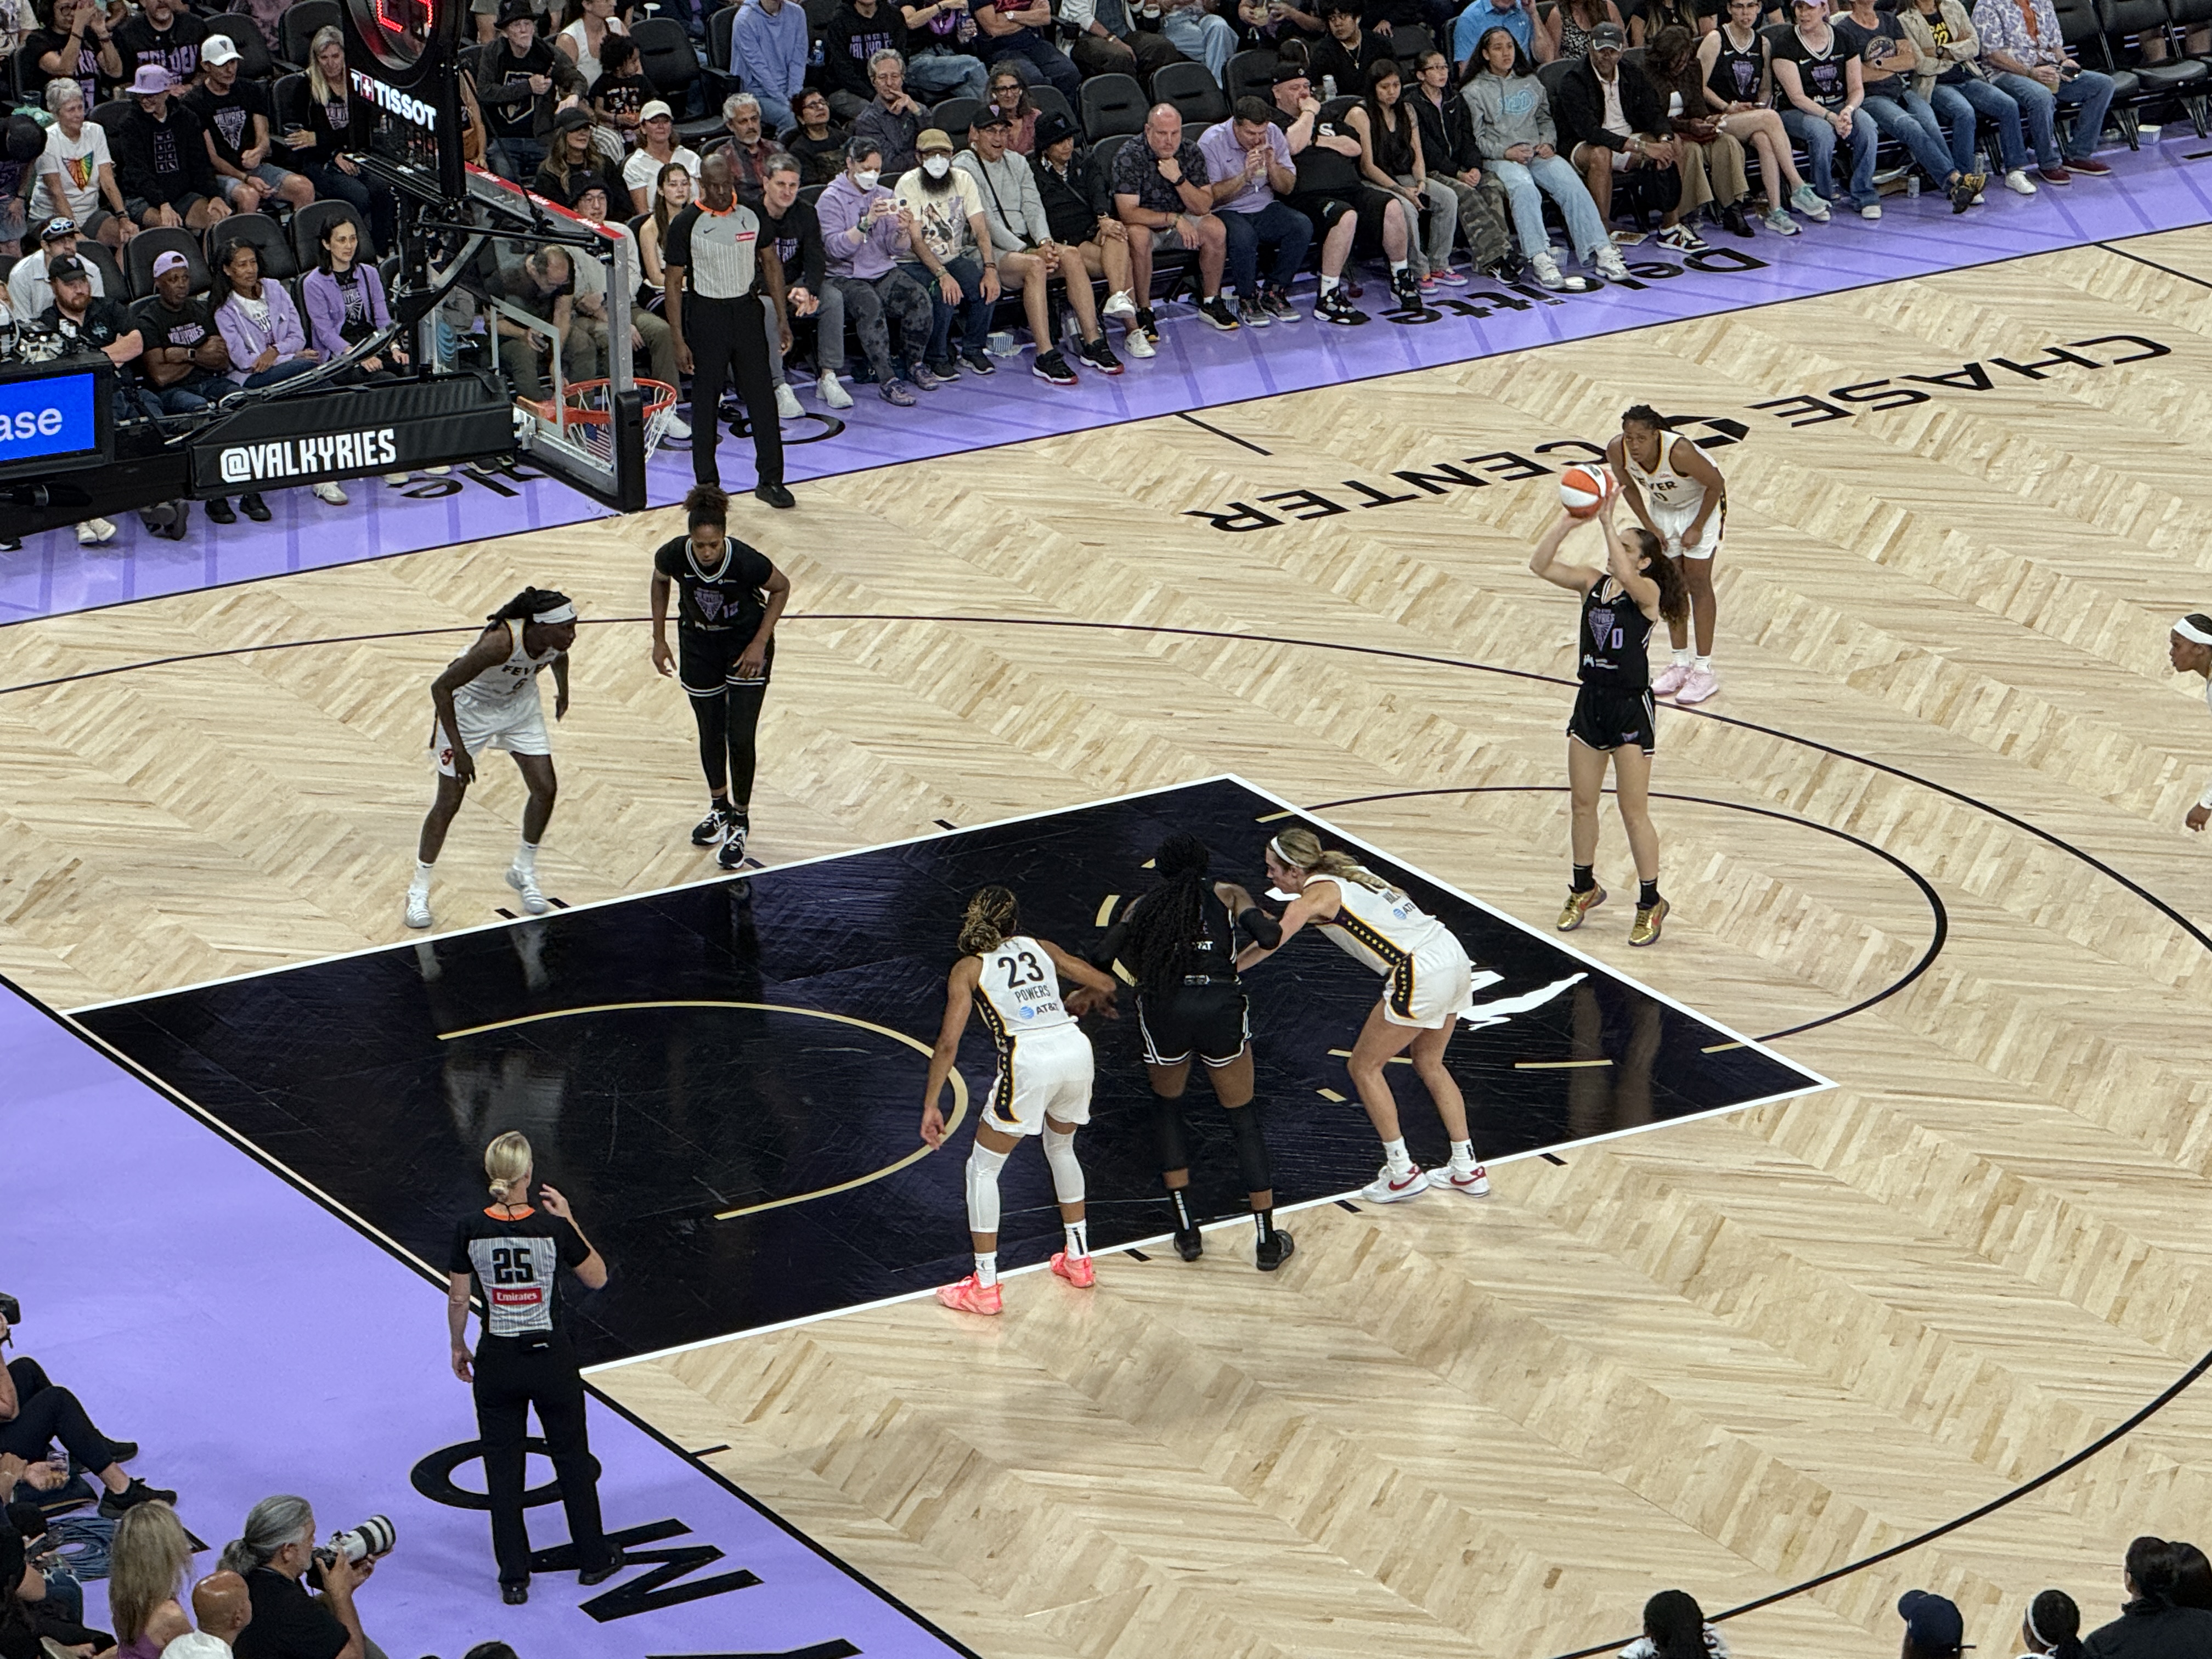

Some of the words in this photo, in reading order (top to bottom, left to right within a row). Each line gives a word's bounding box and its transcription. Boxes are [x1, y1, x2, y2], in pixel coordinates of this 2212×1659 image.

[373, 79, 437, 132] TISSOT
[1743, 335, 2172, 428] CHASE
[221, 428, 397, 483] @VALKYRIES
[1183, 440, 1607, 533] CENTER
[723, 601, 739, 619] 12
[1611, 628, 1623, 650] 0
[997, 951, 1045, 990] 23
[1014, 984, 1051, 1003] POWERS
[492, 1248, 534, 1284] 25
[496, 1291, 538, 1301] Emirates
